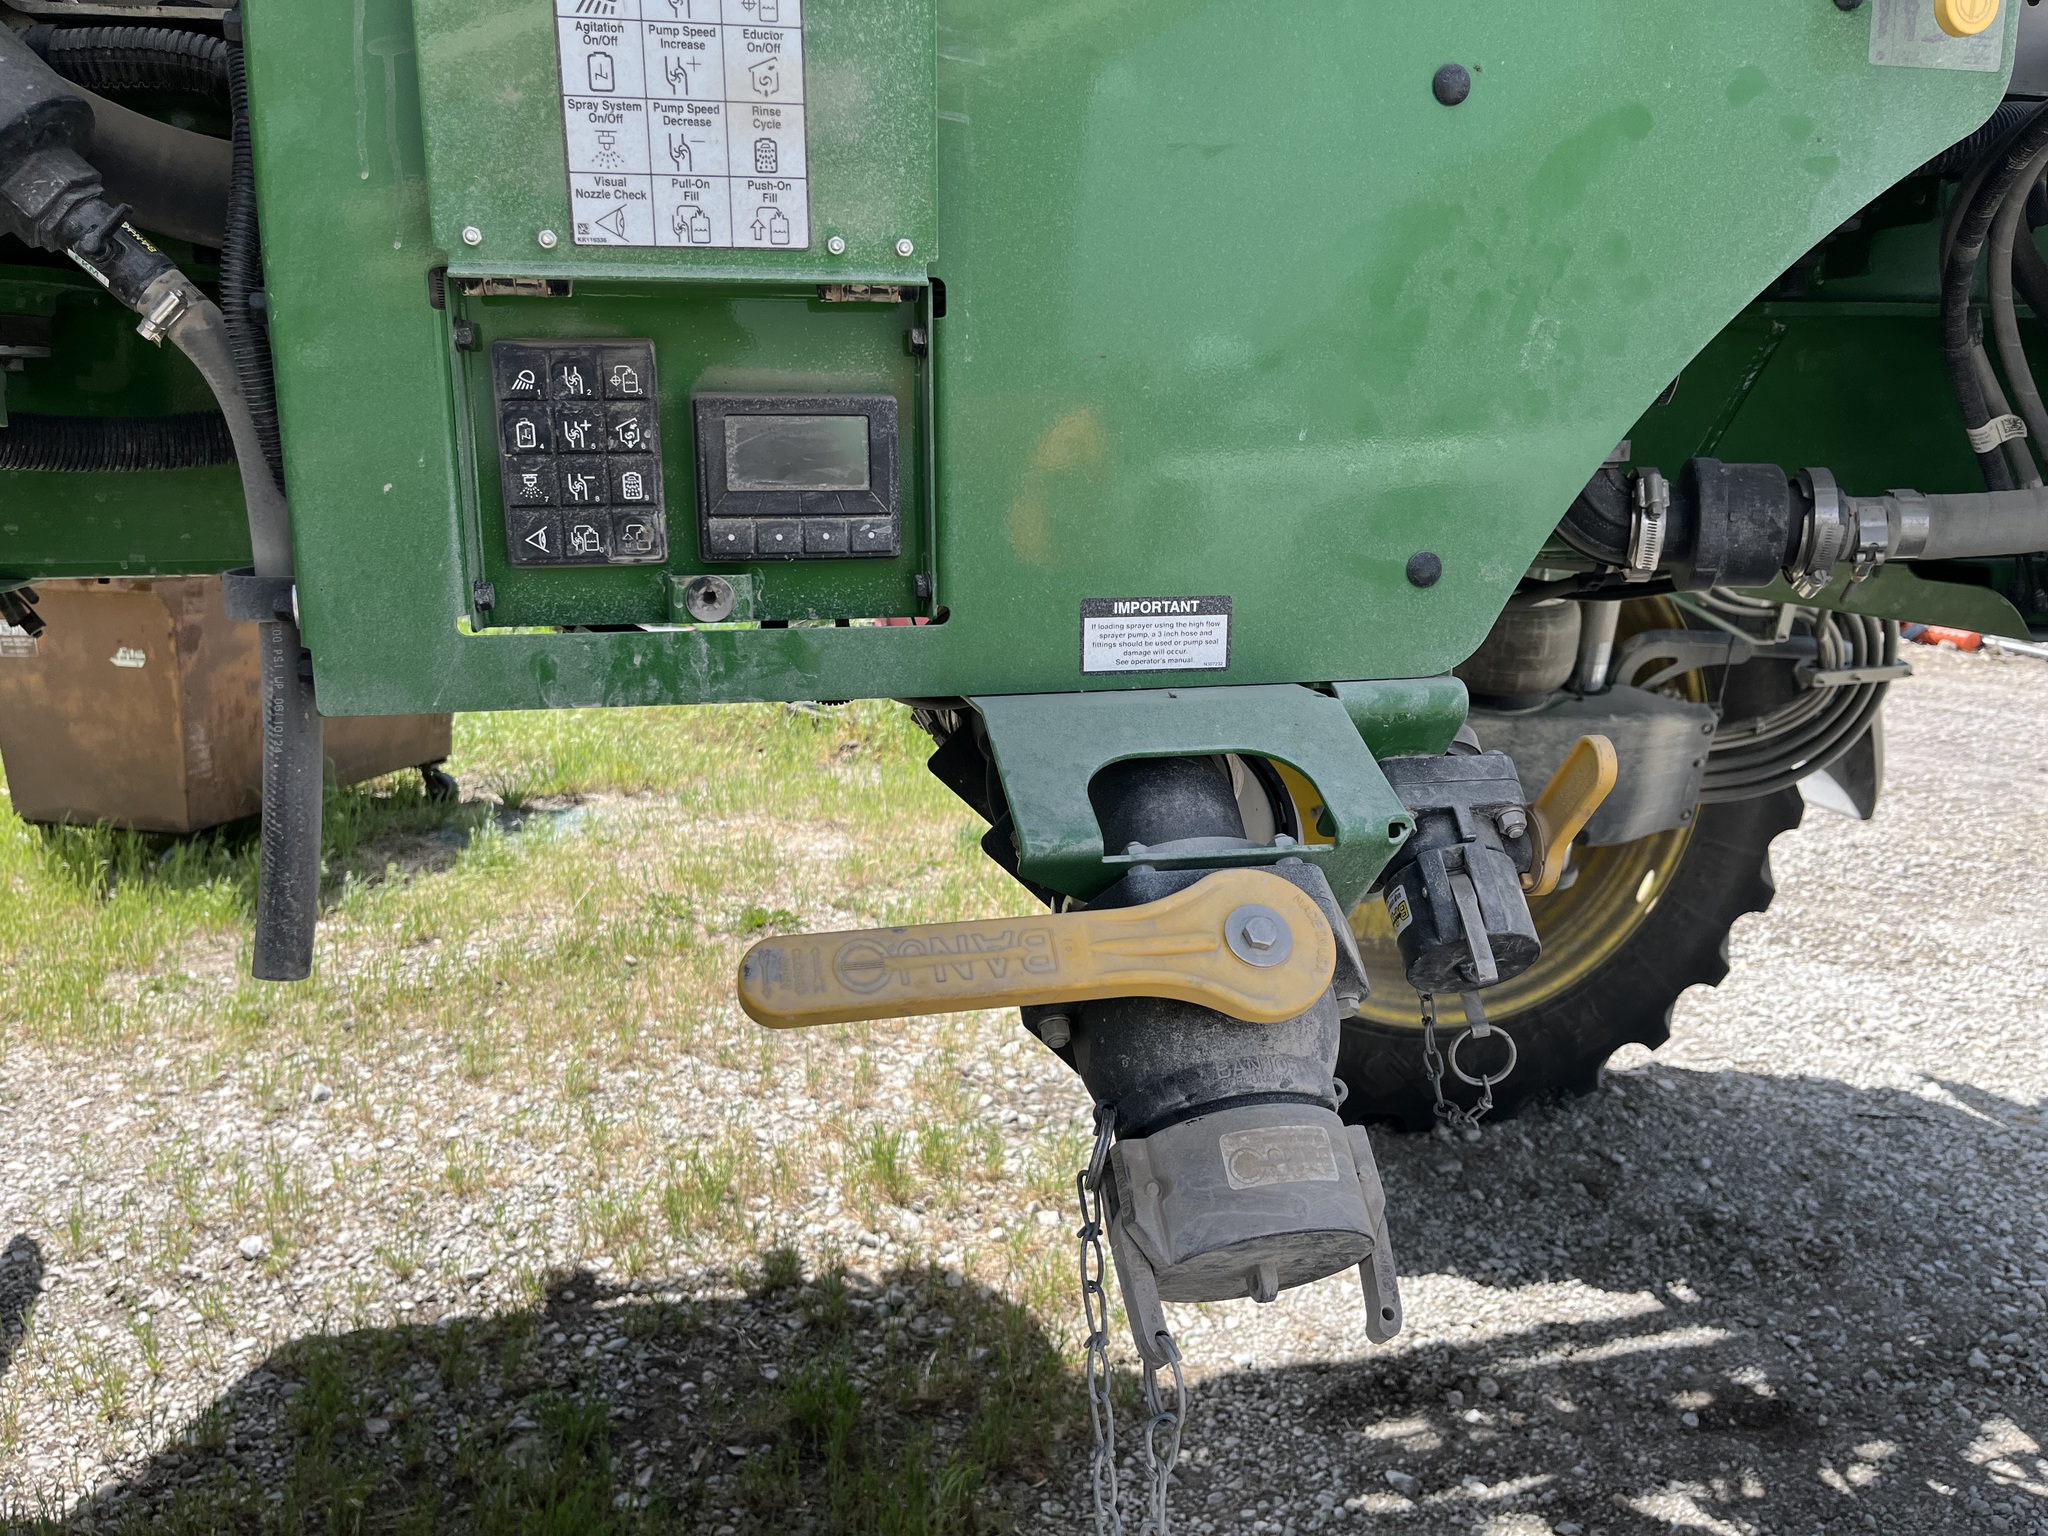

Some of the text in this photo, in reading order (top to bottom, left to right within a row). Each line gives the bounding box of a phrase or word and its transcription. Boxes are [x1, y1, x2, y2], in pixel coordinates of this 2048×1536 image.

[574, 20, 625, 34] Agitation
[649, 25, 716, 40] Pump Speed
[582, 34, 618, 46] On/Off
[743, 29, 784, 41] Eductor
[660, 38, 706, 50] Increase
[746, 42, 781, 54] On/Off
[567, 99, 642, 114] Spray System
[653, 102, 720, 117] Pump Speed
[751, 106, 782, 117] Rinse
[588, 113, 624, 124] On/Off
[663, 115, 712, 127] Decrease
[752, 118, 782, 130] Cycle
[593, 176, 627, 187] Visual
[671, 178, 710, 190] Pull-On
[747, 180, 792, 192] Push-On
[575, 188, 647, 201] Nozzle Check
[684, 190, 700, 202] Fill
[762, 192, 778, 204] Fill
[1114, 600, 1200, 614] IMPORTANT
[1098, 623, 1125, 631] loading
[1126, 623, 1152, 631] sprayer
[1154, 622, 1174, 630] using
[1092, 641, 1117, 649] fittings
[1183, 639, 1203, 647] pump
[273, 649, 284, 669] PSI
[274, 676, 284, 689] WP
[1292, 894, 1330, 973] MADE IN USA
[833, 928, 1059, 994] BANJO
[1214, 1056, 1290, 1079] BANJO
[1221, 1073, 1294, 1089] CORPORATION
[1113, 1150, 1131, 1217] BANJO
